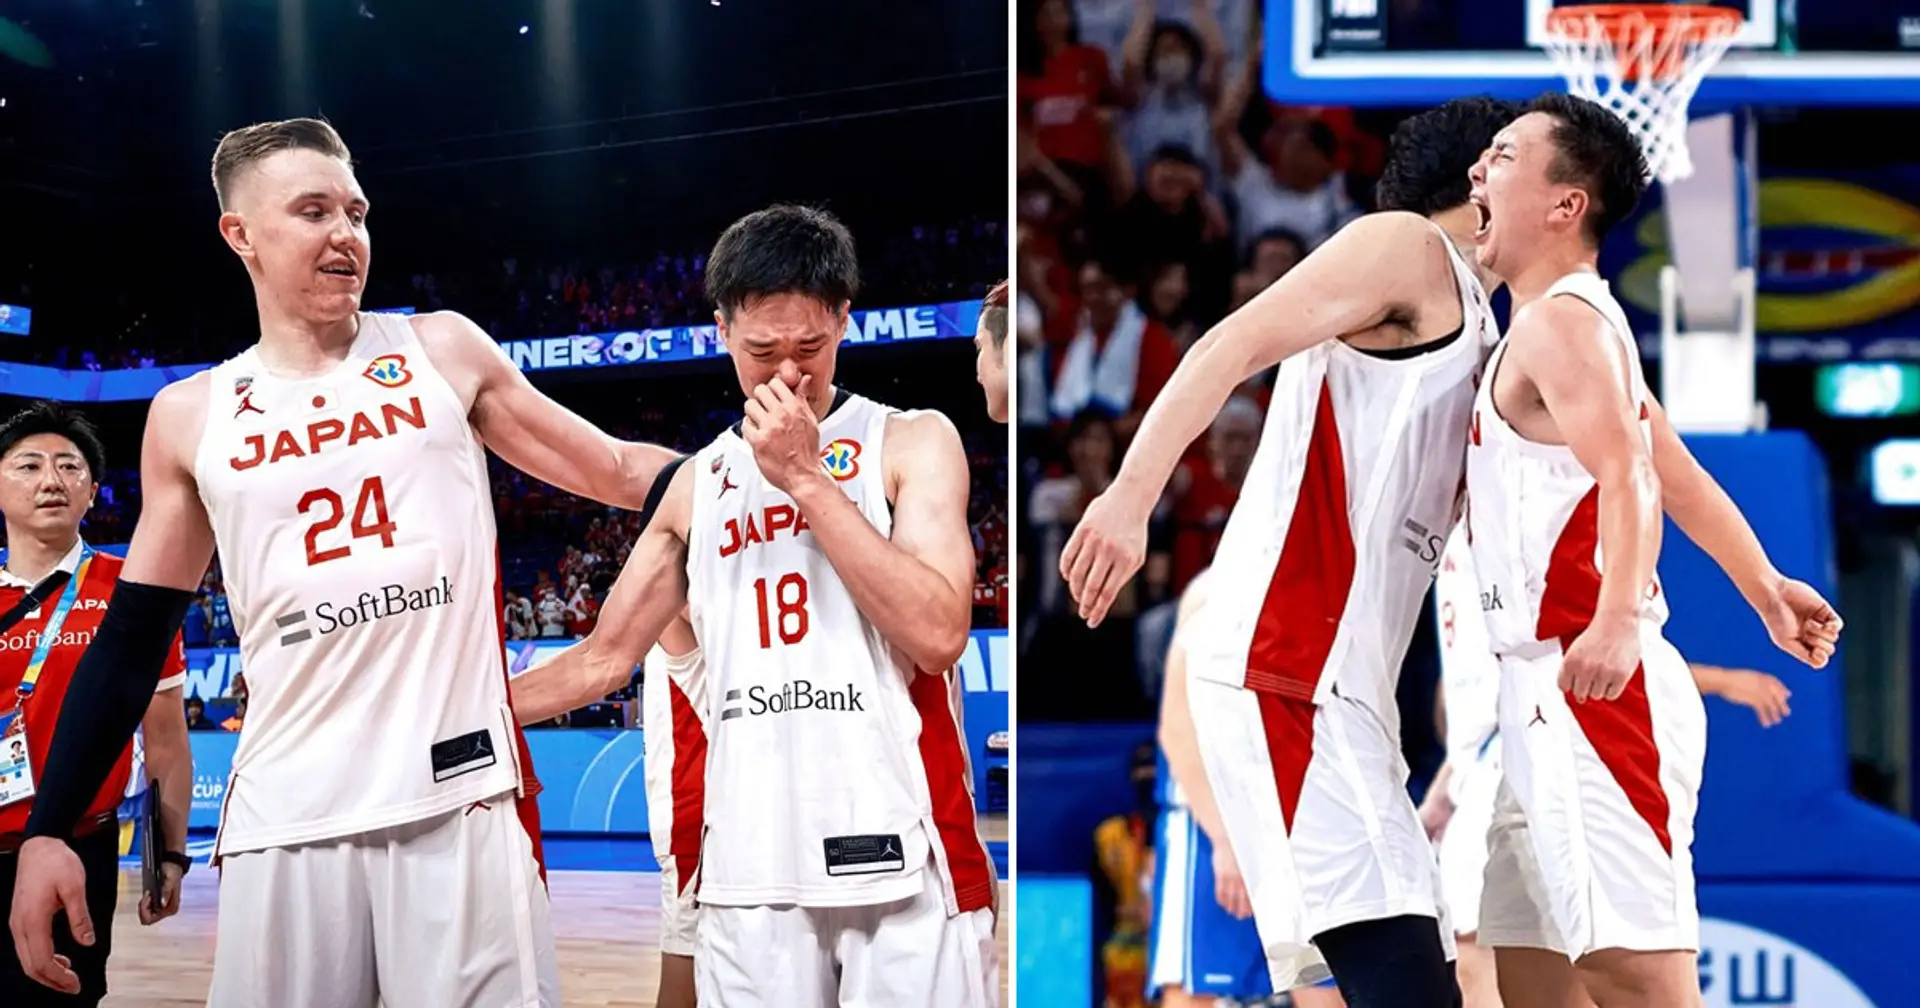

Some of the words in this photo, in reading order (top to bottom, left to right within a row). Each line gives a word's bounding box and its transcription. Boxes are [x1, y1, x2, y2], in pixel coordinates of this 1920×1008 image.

[608, 328, 673, 362] OF
[229, 396, 427, 471] JAPAN
[296, 475, 397, 566] 24
[315, 576, 454, 634] SoftBank
[753, 571, 809, 649] 18
[748, 679, 865, 716] SoftBank
[192, 783, 224, 798] CUP
